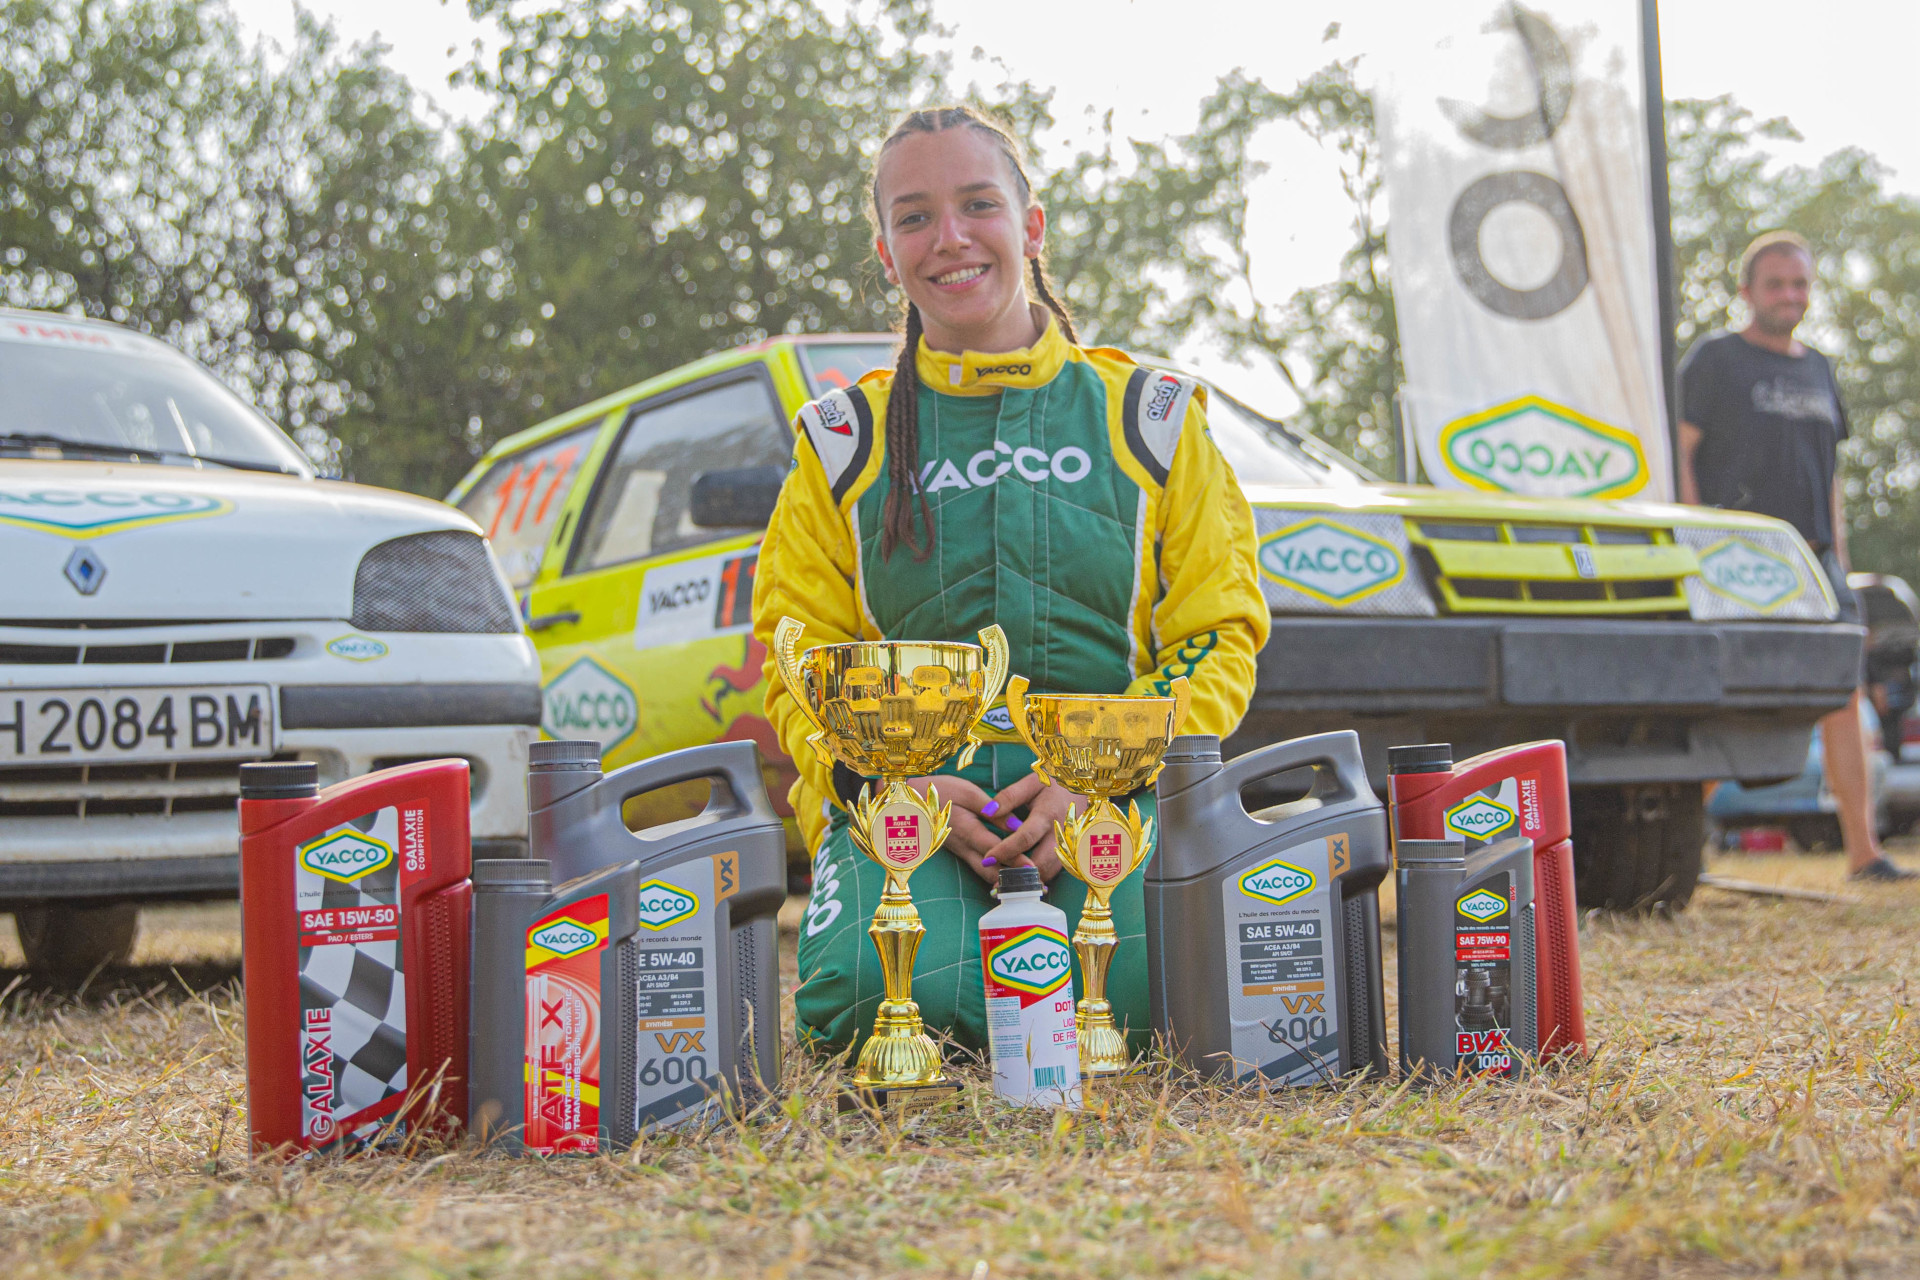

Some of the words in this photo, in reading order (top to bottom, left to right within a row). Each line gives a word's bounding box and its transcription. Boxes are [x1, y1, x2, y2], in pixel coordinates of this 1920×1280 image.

[975, 364, 1031, 377] YACCO
[909, 440, 1092, 495] YACCO
[0, 490, 192, 508] ACCO
[1273, 547, 1387, 574] YACCO
[650, 579, 711, 615] YACCO
[1143, 630, 1218, 698] ACCO
[548, 691, 629, 729] YACCO
[985, 713, 1011, 723] YAC
[39, 695, 177, 754] 2084
[190, 693, 261, 749] BM
[1522, 779, 1534, 830] GALAXIE
[1531, 779, 1540, 830] COMPETITION
[1457, 812, 1504, 825] YACCO
[405, 809, 418, 871] GALAXIE
[417, 809, 426, 870] COMPETITION
[316, 847, 379, 865] YACCO
[1333, 839, 1345, 871] VX
[720, 858, 734, 893] VX
[1251, 875, 1305, 890] YACCO
[640, 898, 686, 912] ACCO
[1465, 901, 1501, 911] YACCO
[304, 912, 334, 928] SAE
[339, 908, 395, 926] 15W-50
[350, 933, 373, 941] ESTERS
[541, 932, 589, 944] YACCO
[1246, 925, 1271, 939] SAE
[1274, 923, 1314, 937] 5W-40
[1460, 936, 1475, 945] SAE
[1477, 935, 1506, 945] 75W-90
[650, 951, 696, 967] 5W-40
[1001, 950, 1068, 973] YACCO
[658, 973, 679, 981] A3/B4
[541, 998, 563, 1030] X
[573, 999, 581, 1034] FLUID
[1055, 1000, 1071, 1012] DOT
[1280, 994, 1326, 1015] VX
[564, 989, 572, 1059] AUTOMATIC
[1268, 1016, 1327, 1043] 600
[654, 1030, 706, 1053] VX
[1053, 1032, 1064, 1042] DE
[1456, 1028, 1511, 1055] BVX
[307, 1007, 335, 1141] GALAXIE
[640, 1055, 707, 1086] 600
[1478, 1055, 1511, 1069] 1000
[540, 1045, 564, 1129] ATF
[573, 1037, 581, 1130] TRANSMISSION
